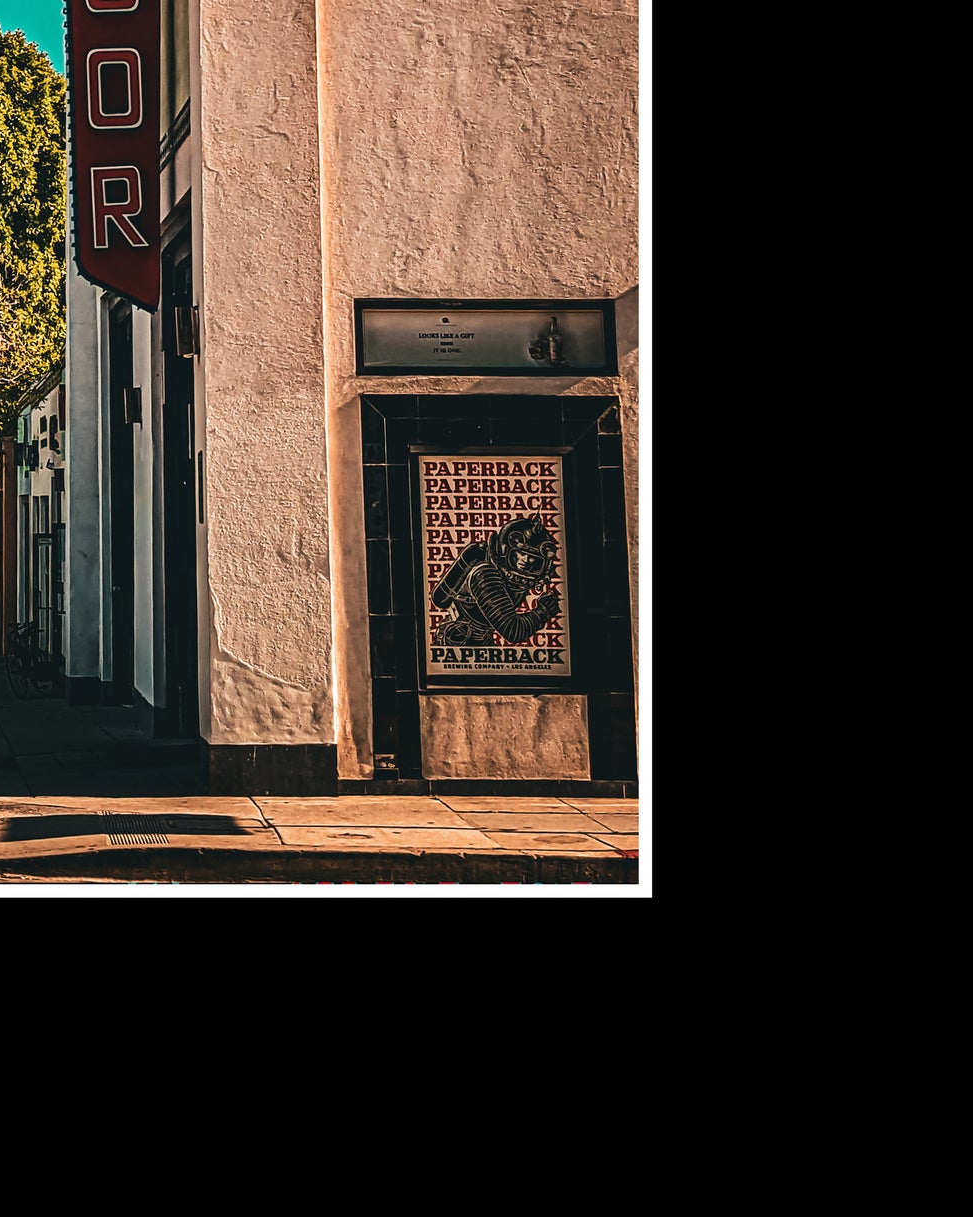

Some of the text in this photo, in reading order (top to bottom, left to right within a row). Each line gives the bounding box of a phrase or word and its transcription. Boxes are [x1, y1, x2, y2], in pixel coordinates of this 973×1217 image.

[423, 461, 559, 477] PAPERBACK
[424, 478, 560, 494] PAPERBACK
[425, 495, 560, 511] PAPERBACK
[430, 648, 566, 664] PAPERBACK
